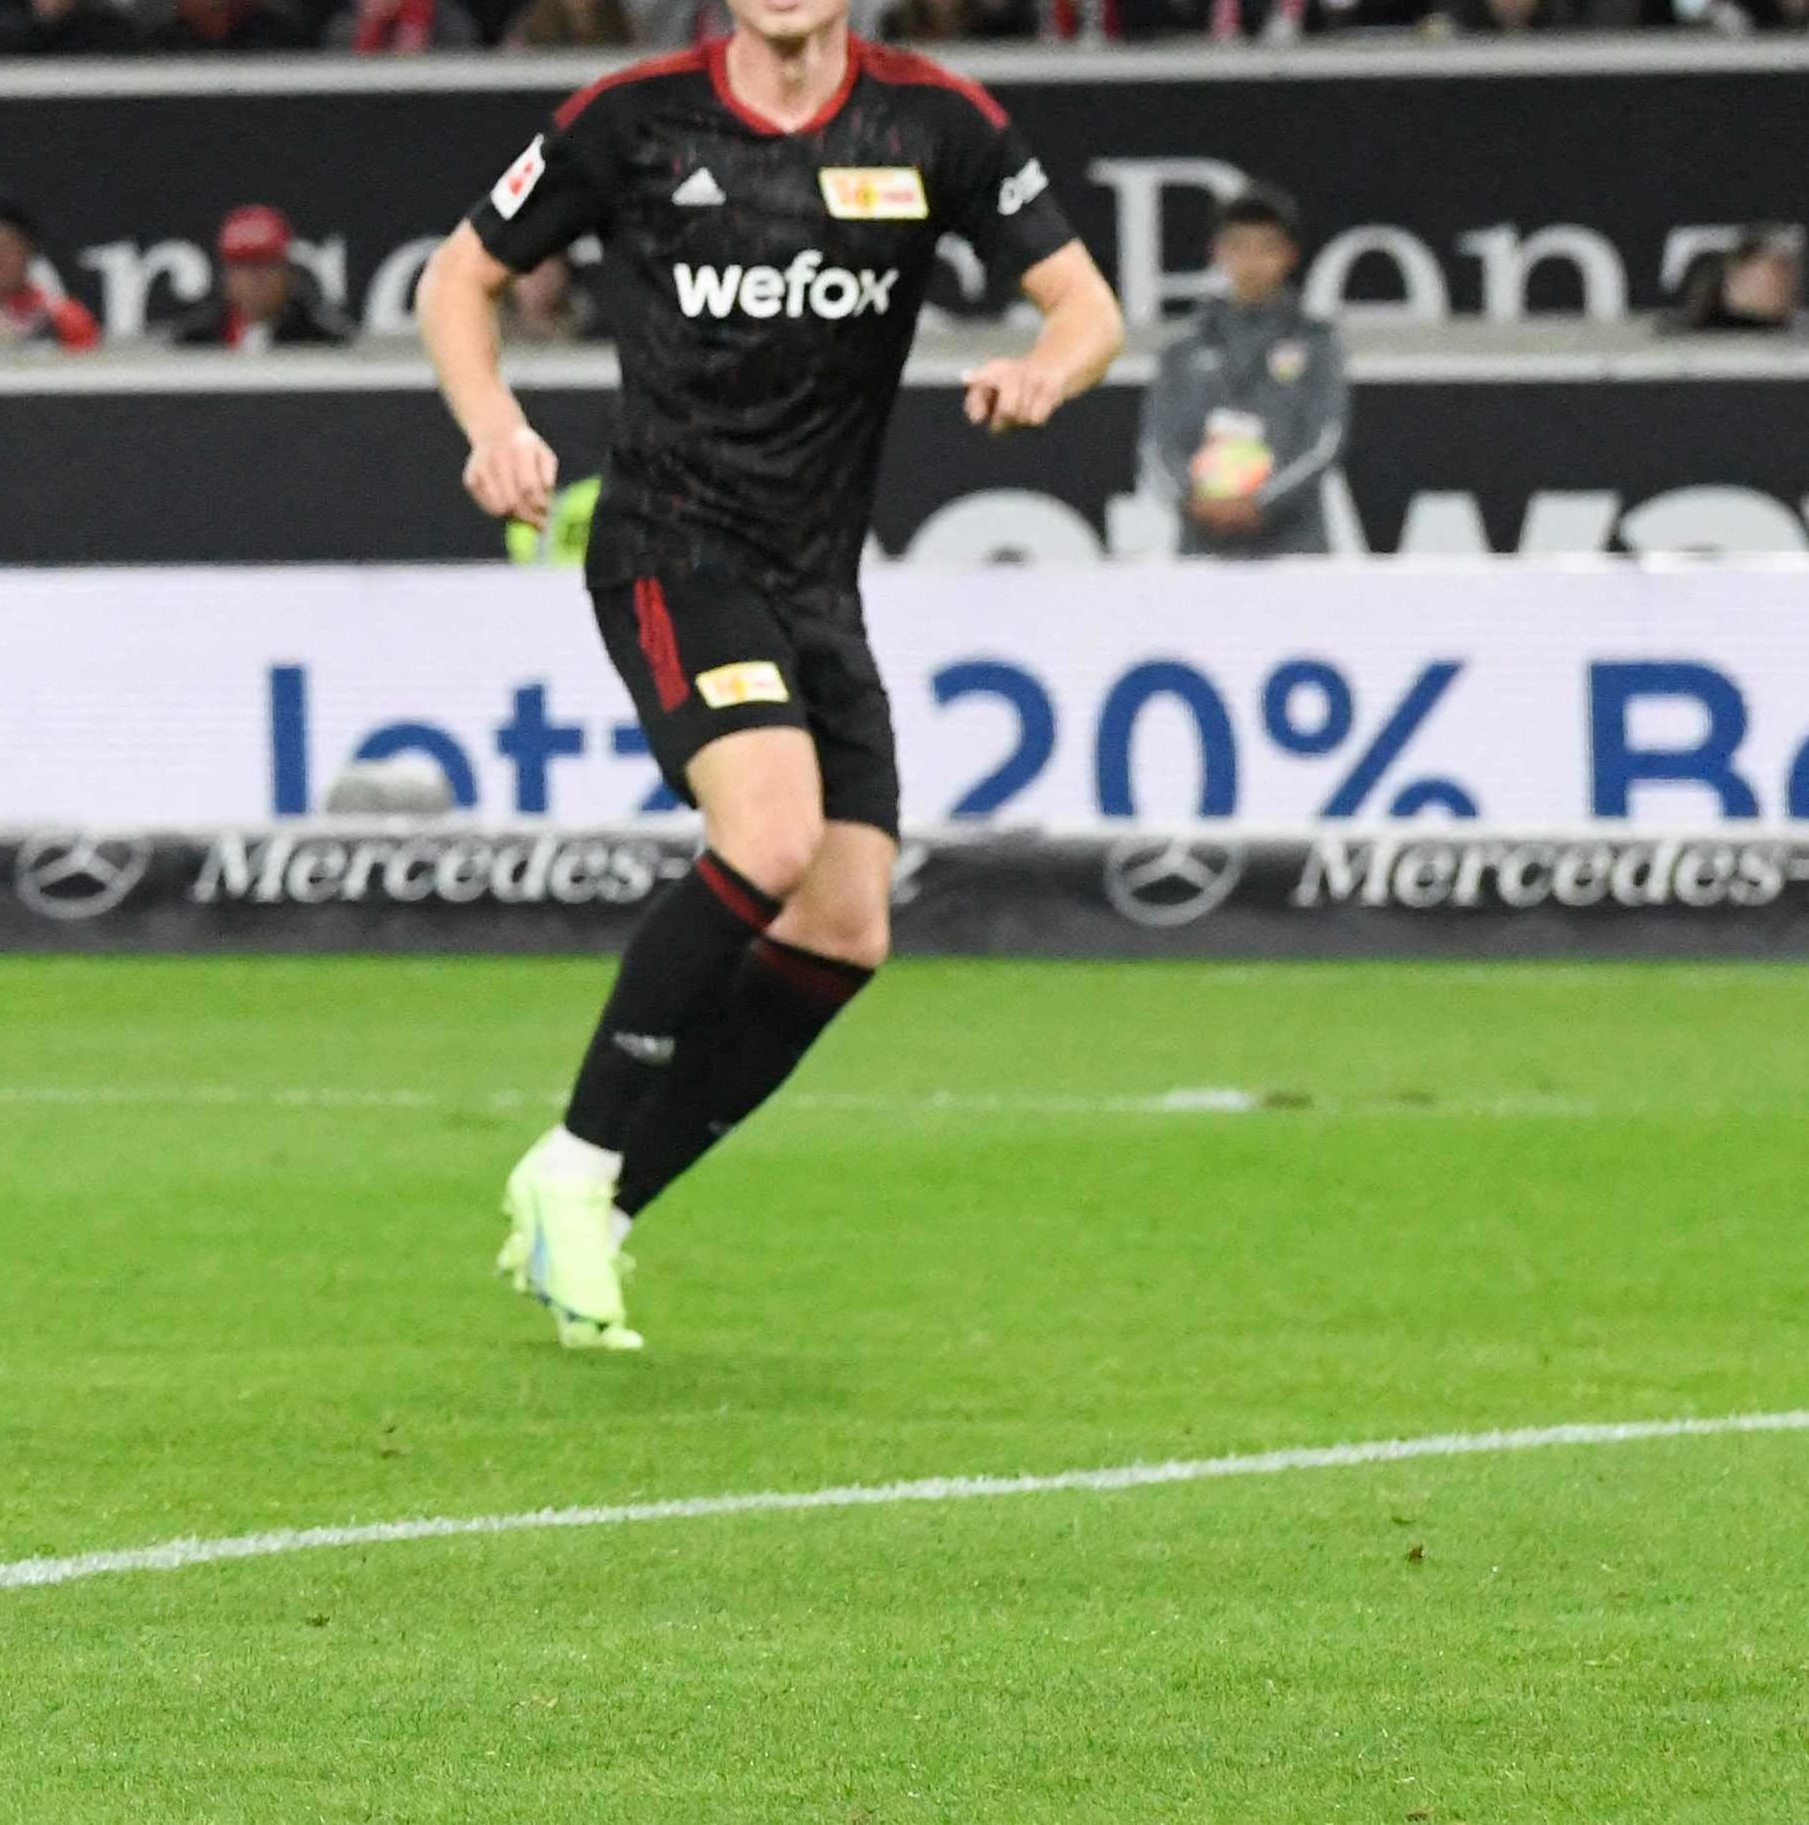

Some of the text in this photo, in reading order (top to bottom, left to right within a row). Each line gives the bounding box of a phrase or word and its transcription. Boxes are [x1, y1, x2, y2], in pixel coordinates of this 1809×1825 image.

[672, 248, 899, 320] wefox
[930, 657, 1479, 821] 20%
[1589, 658, 1809, 821] B
